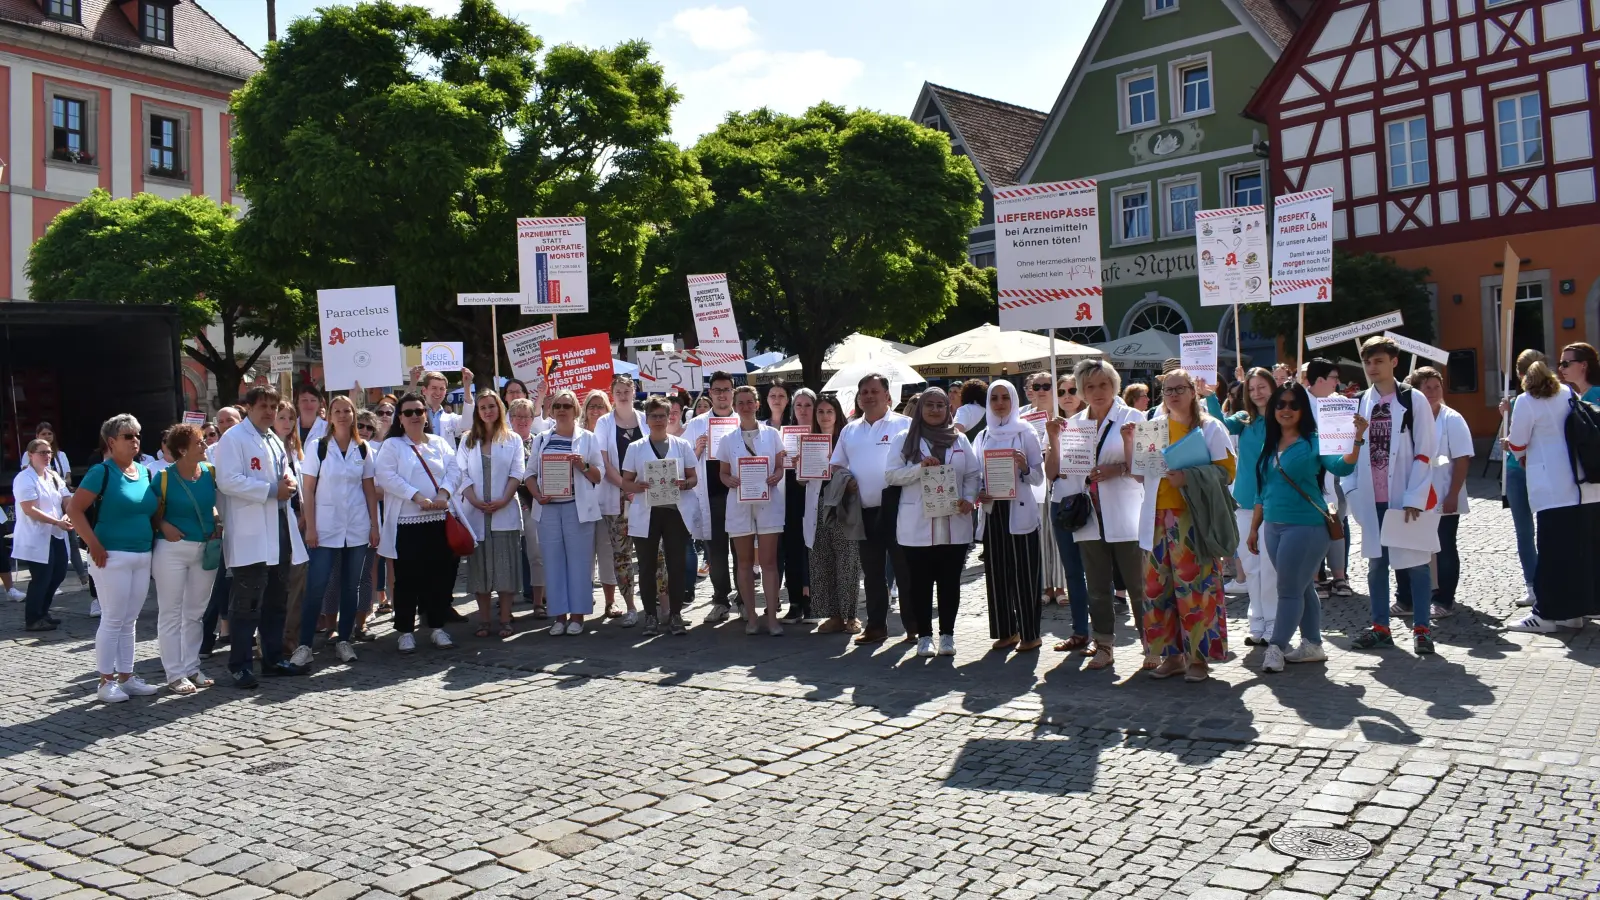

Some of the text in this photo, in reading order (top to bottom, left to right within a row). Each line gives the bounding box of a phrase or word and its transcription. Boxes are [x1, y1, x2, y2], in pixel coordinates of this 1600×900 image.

[997, 207, 1096, 223] LIEFERENGPÄSSE
[1278, 212, 1316, 223] RESPEKT &
[1005, 223, 1088, 236] bei Arzneimitteln
[1280, 221, 1327, 234] FAIRER LOHN
[520, 230, 571, 238] ARZNEIMITTEL
[1307, 235, 1327, 243] Arbeit!
[1013, 235, 1081, 248] können töten!
[536, 244, 584, 252] BÜROKRATIE-
[1036, 256, 1096, 266] Herzmedikamente
[1134, 254, 1196, 279] Neptu
[1283, 259, 1306, 268] morgen
[694, 294, 725, 303] PROTESTTAG
[326, 306, 389, 318] Paracelsus
[1315, 316, 1397, 344] Steigerwald-Apotheke
[328, 327, 389, 345] Apotheke
[562, 348, 596, 360] HÄNGEN
[565, 358, 586, 367] REIN.
[1018, 361, 1042, 370] Hofmann
[548, 371, 561, 380] DIE
[564, 363, 610, 376] REGIERUNG
[638, 357, 700, 389] WEST
[918, 366, 948, 374] Hofmann
[959, 365, 990, 373] Hofmann
[548, 376, 573, 387] LÄSST
